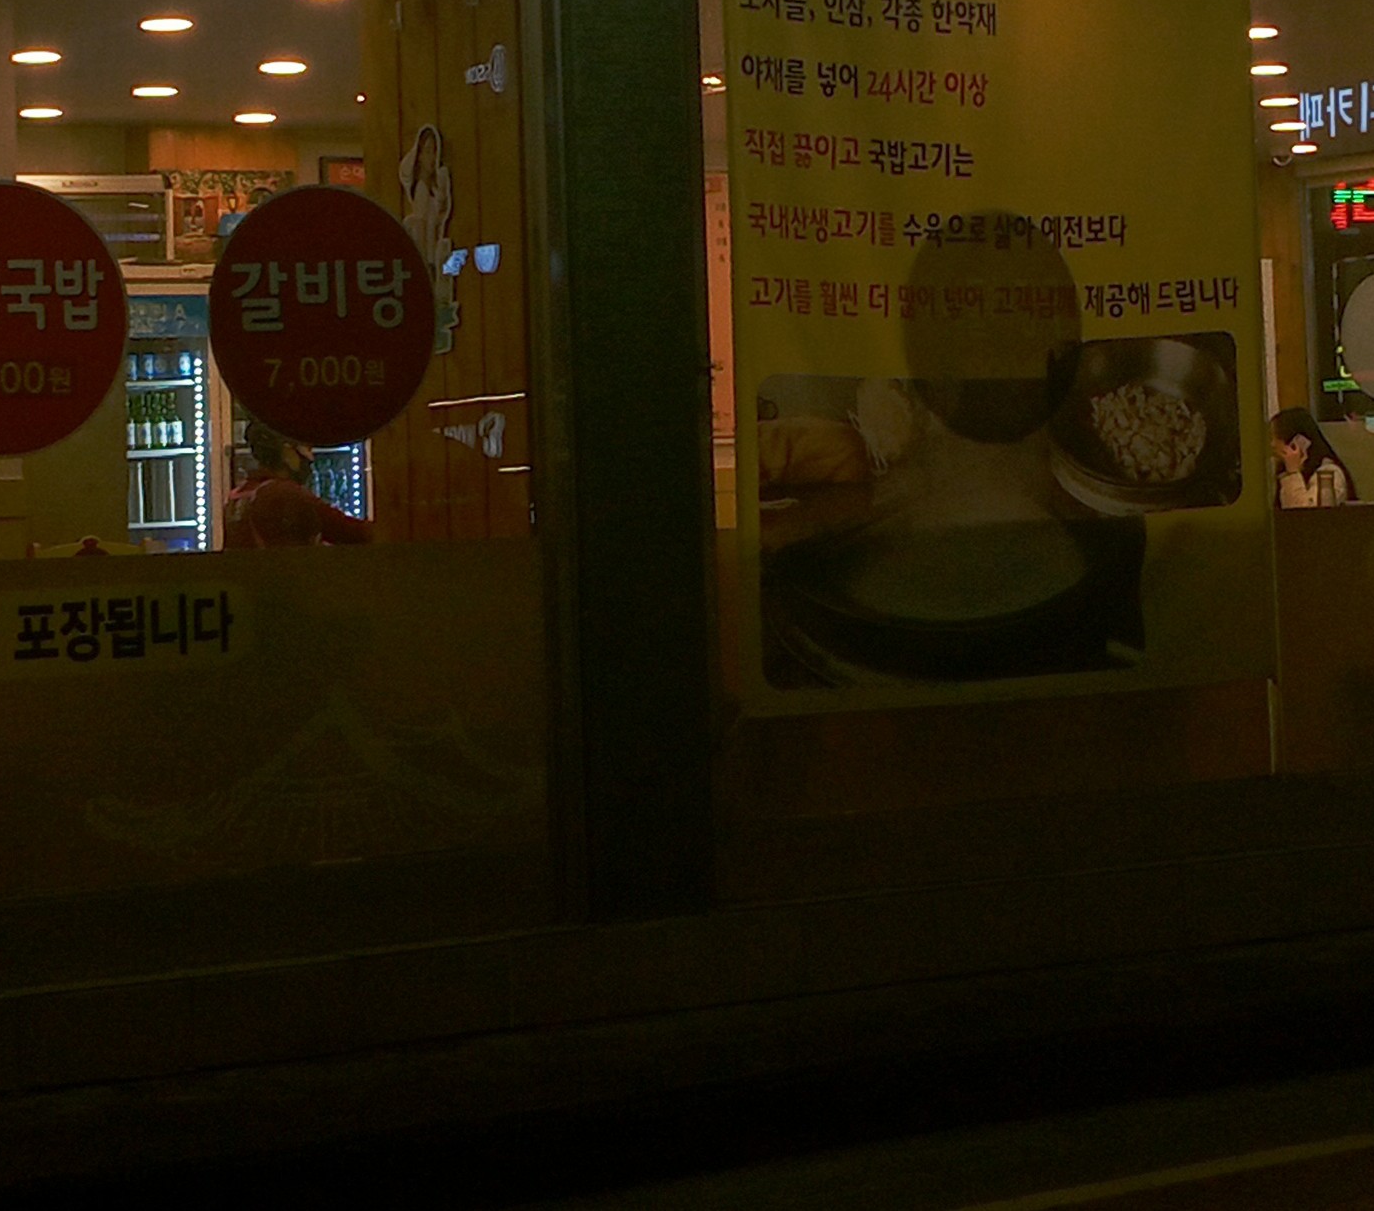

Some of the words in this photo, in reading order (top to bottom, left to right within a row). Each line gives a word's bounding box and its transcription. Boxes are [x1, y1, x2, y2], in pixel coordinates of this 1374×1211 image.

[741, 54, 807, 95] 야채를
[817, 61, 859, 99] 넣어
[866, 69, 937, 104] 24시간
[944, 72, 989, 108] 이상
[745, 129, 785, 166] 직접
[793, 133, 861, 170] 끓이고
[868, 139, 974, 178] 국밥고기는
[748, 203, 896, 247] 국내산생고기를
[903, 213, 987, 249] 수육으로
[1040, 214, 1127, 248] 예전보다
[230, 259, 413, 332] 갈비탕
[749, 277, 812, 315] 고기를
[819, 280, 859, 317] 훨씬
[868, 284, 889, 318] 더
[1084, 281, 1151, 318] 제공해
[1156, 276, 1239, 313] 드립니다
[14, 590, 234, 662] 포장됩니다
